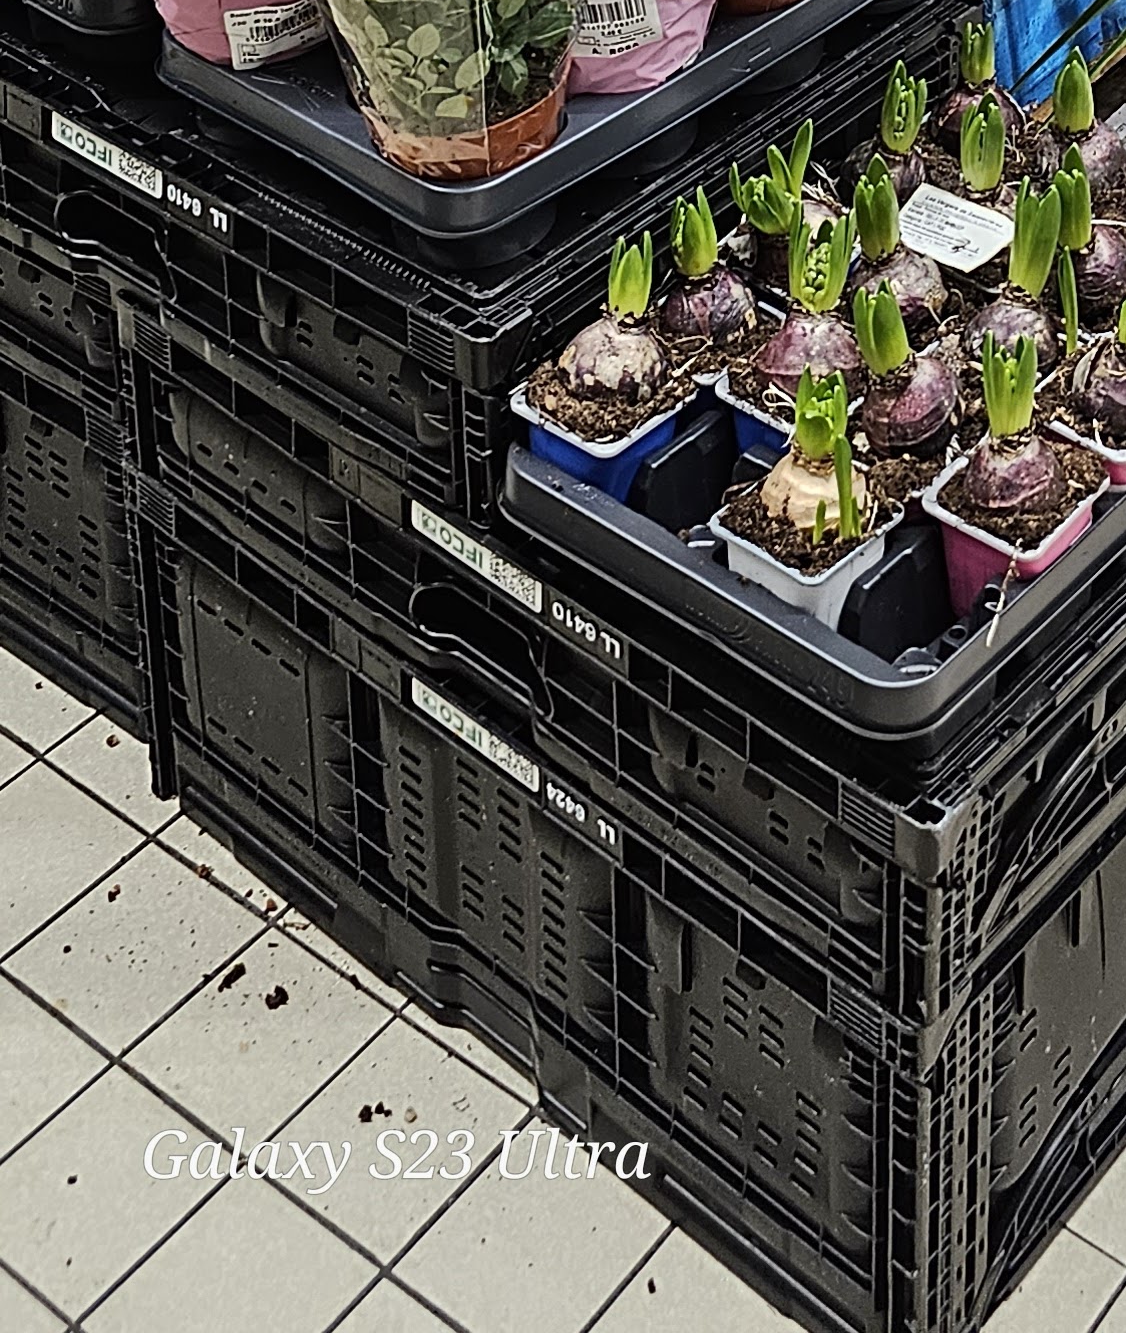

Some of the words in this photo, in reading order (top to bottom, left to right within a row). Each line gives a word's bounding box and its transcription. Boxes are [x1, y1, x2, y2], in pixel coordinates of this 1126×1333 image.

[75, 132, 113, 167] IFCO
[167, 184, 202, 217] 6410
[209, 207, 228, 233] LL
[440, 527, 483, 569] IFCO
[552, 601, 596, 642] 6410
[600, 631, 620, 659] LL
[440, 707, 482, 748] IFCO
[546, 783, 586, 823] 6424
[597, 819, 616, 846] LL
